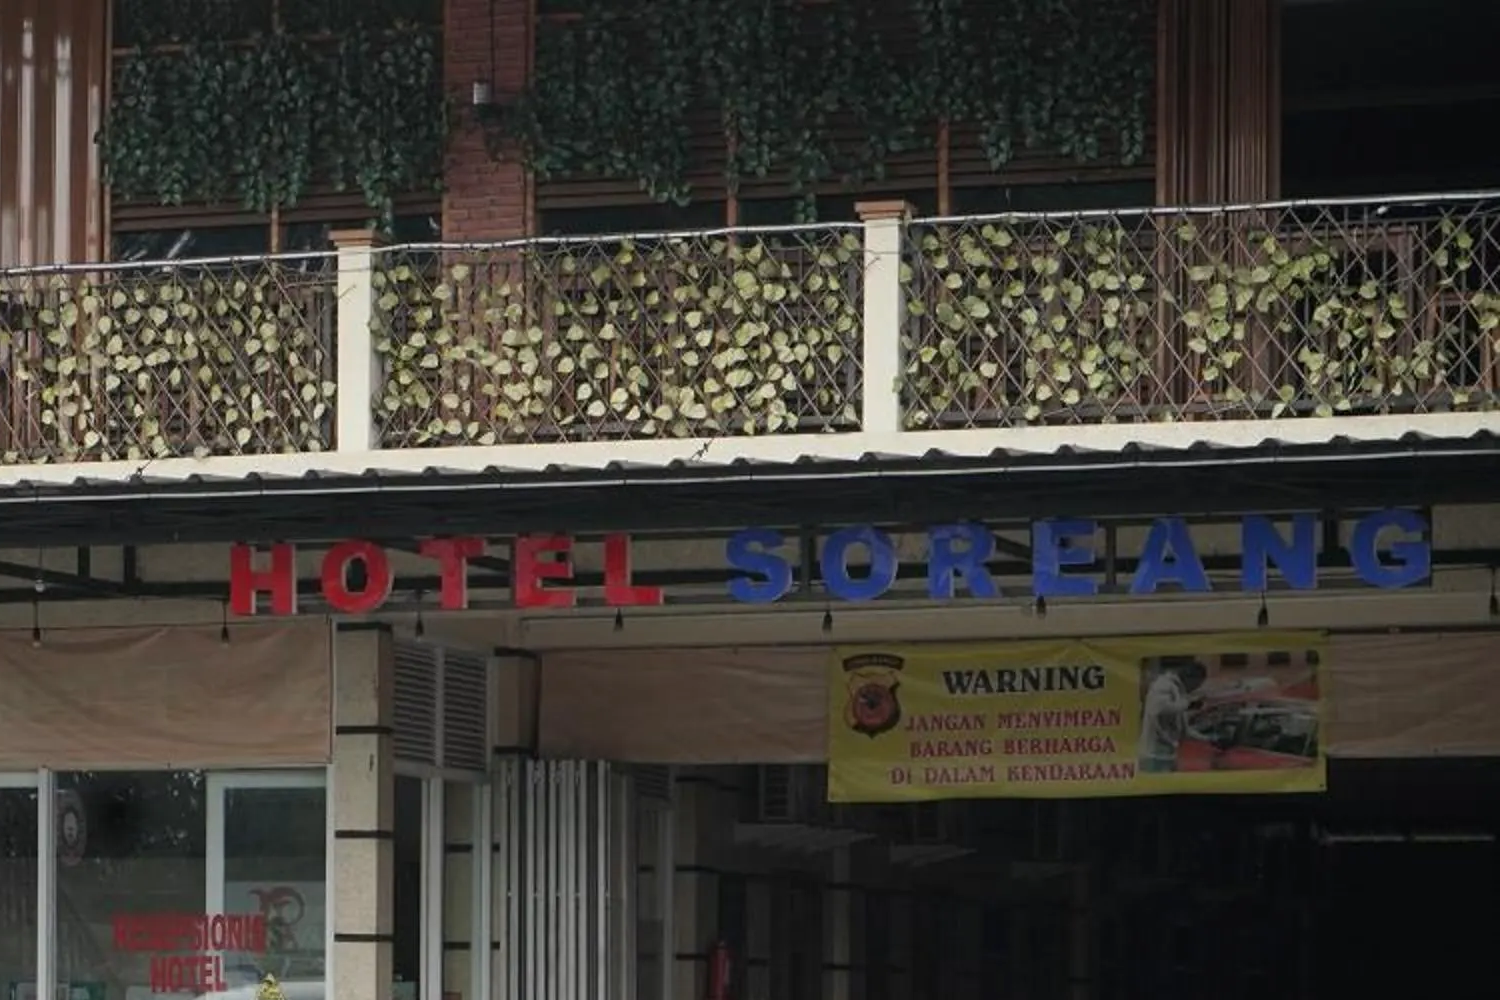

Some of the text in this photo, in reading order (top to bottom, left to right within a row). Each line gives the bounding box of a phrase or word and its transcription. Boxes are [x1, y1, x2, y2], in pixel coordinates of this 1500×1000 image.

[229, 506, 1432, 616] HOTEL SOREANG
[942, 665, 1106, 695] WARNING
[904, 708, 1121, 732] JANGAN MENYIMPAN
[910, 736, 1116, 758] BARANG BERHARGA
[924, 765, 995, 785] DALAM
[1007, 762, 1136, 782] KENDARAAN
[150, 955, 227, 994] HOTEL
